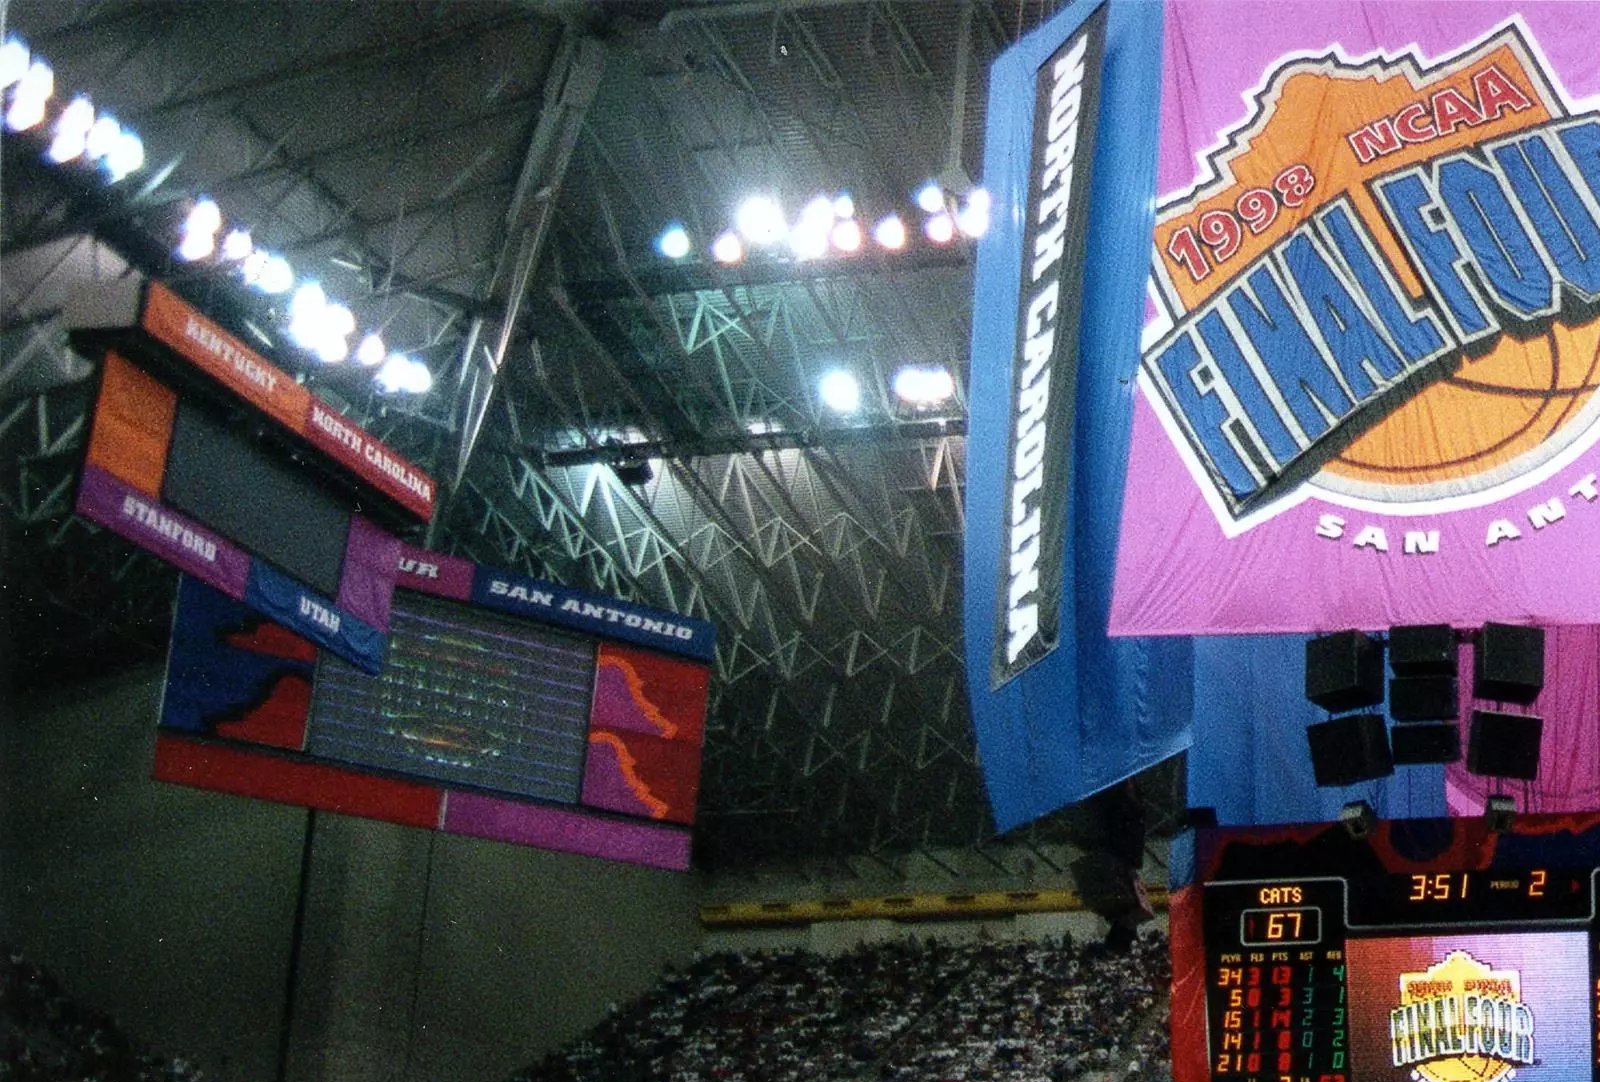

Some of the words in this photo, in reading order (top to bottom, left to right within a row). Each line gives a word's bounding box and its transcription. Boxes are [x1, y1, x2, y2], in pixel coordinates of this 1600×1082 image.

[1032, 34, 1088, 282] NORTH
[1166, 163, 1316, 283] 1998
[1348, 64, 1531, 166] NCAA
[186, 316, 277, 393] KENTUCKY
[1146, 190, 1440, 500] FINAL
[311, 405, 362, 456] NORTH
[363, 442, 431, 503] CAROLINA
[1004, 283, 1059, 665] CAROLINA
[122, 495, 216, 562] STANFORD
[1315, 512, 1442, 554] SAN
[299, 594, 342, 634] UTAH
[488, 580, 553, 608] SAN
[560, 598, 691, 641] ANTONIO
[1260, 887, 1303, 905] CATS
[1410, 874, 1468, 900] 3:51
[1528, 871, 1546, 897] 2
[1267, 912, 1302, 939] 67
[1217, 967, 1243, 986] 34
[1332, 964, 1345, 982] 4
[1224, 1010, 1242, 1028] 15
[1332, 1008, 1344, 1025] 3
[1230, 989, 1243, 1007] 5
[1224, 1033, 1242, 1050] 14
[1302, 1031, 1314, 1047] 0
[1332, 1029, 1344, 1047] 2
[1391, 997, 1466, 1066] FINAL
[1466, 996, 1535, 1065] FOUR
[1217, 1053, 1242, 1072] 21
[1332, 1051, 1345, 1069] 0
